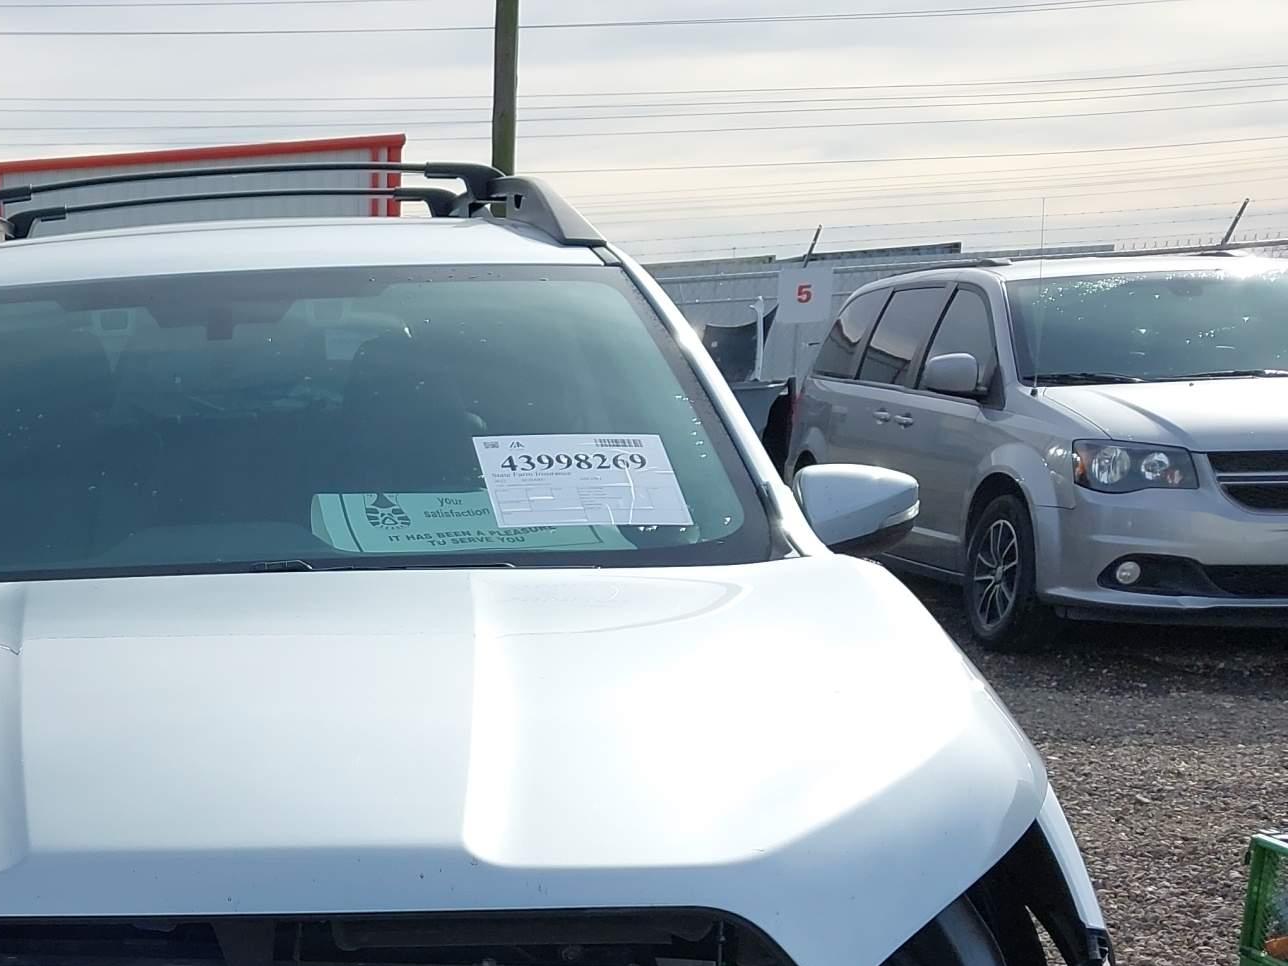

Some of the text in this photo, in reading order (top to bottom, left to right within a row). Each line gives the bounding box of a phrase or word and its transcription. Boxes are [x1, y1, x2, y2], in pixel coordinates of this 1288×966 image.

[797, 284, 812, 303] 5
[500, 453, 647, 472] 43998269
[437, 496, 463, 508] your
[424, 507, 491, 519] satisfaction
[406, 533, 433, 541] HAS
[436, 530, 472, 539] BEEN
[450, 536, 496, 545] SERVE
[497, 535, 525, 544] YOU
